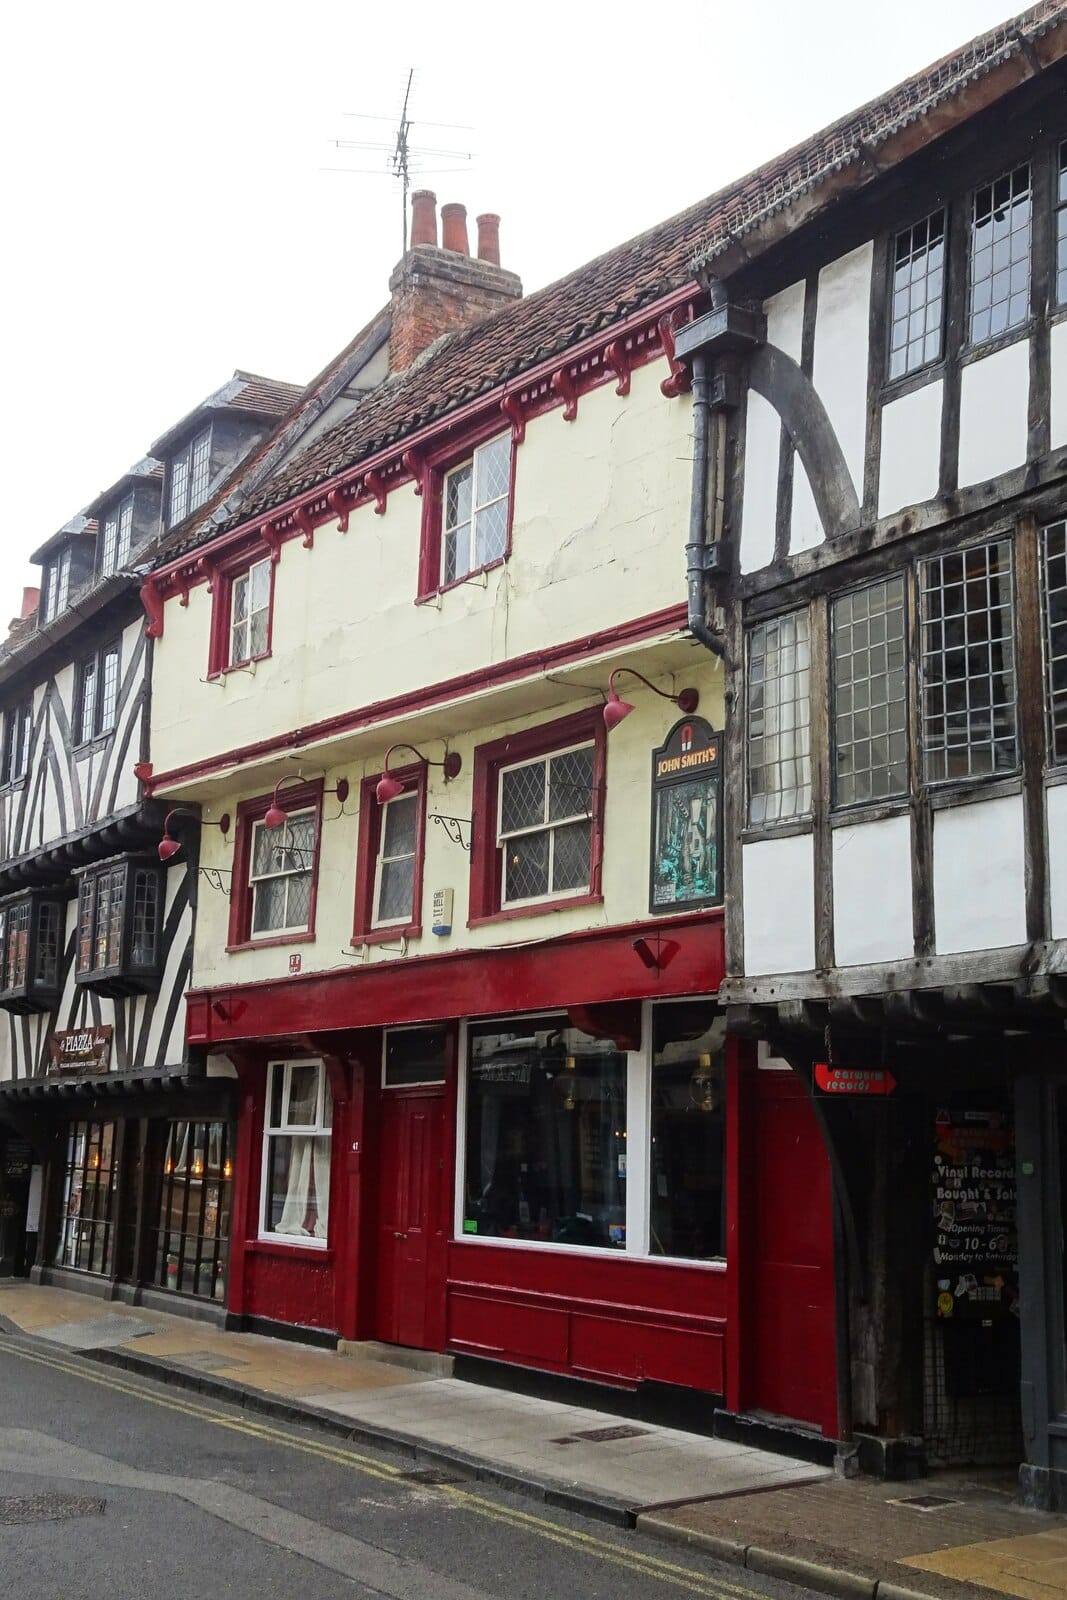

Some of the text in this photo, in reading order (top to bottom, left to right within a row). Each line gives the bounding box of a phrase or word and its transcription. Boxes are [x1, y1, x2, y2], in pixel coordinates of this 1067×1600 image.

[657, 747, 717, 777] JOHN SMITH'S
[65, 1034, 93, 1052] PIAZZA
[834, 1070, 884, 1080] earworm
[826, 1081, 870, 1090] records
[937, 1165, 968, 1179] Vinyl
[972, 1166, 1016, 1178] Record
[936, 1187, 980, 1202] Bought
[983, 1189, 992, 1200] &
[951, 1223, 986, 1235] Opening
[964, 1237, 979, 1250] 10
[988, 1238, 997, 1250] 6
[940, 1252, 973, 1264] Monday
[975, 1253, 984, 1262] to
